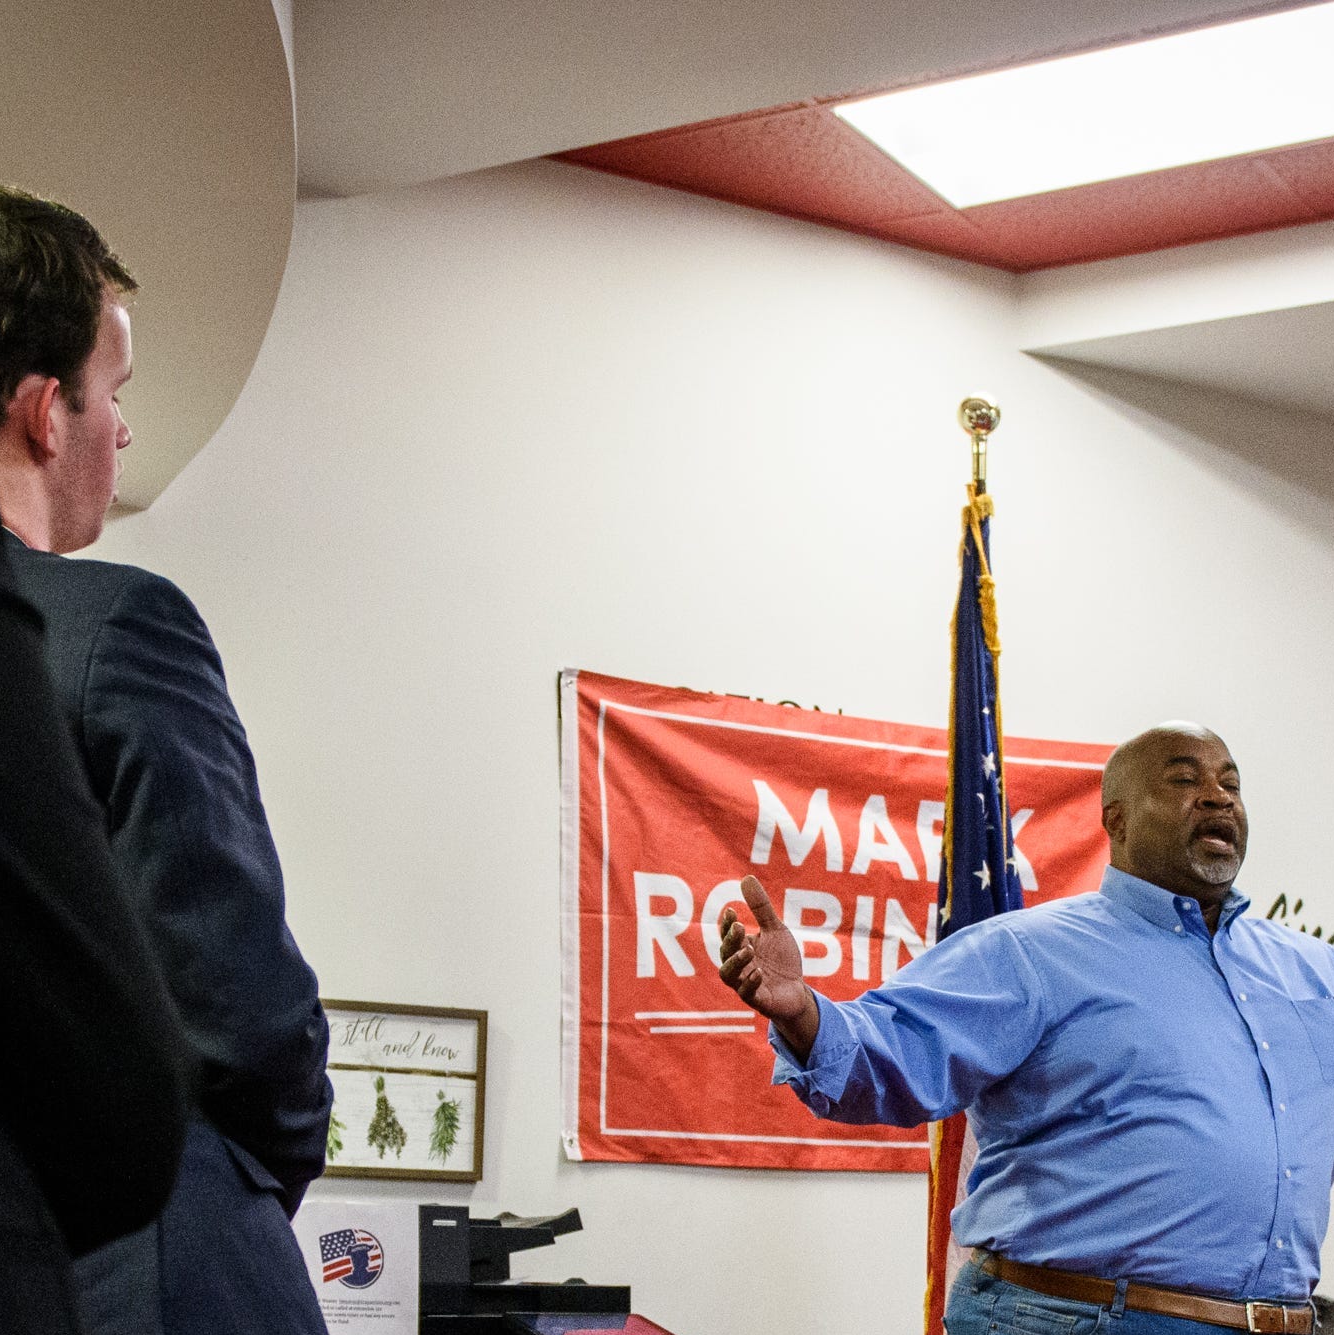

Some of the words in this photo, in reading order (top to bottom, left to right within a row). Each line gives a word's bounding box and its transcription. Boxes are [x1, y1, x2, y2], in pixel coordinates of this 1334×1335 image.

[340, 1015, 386, 1047] still
[382, 1031, 421, 1059] and
[422, 1034, 460, 1060] know
